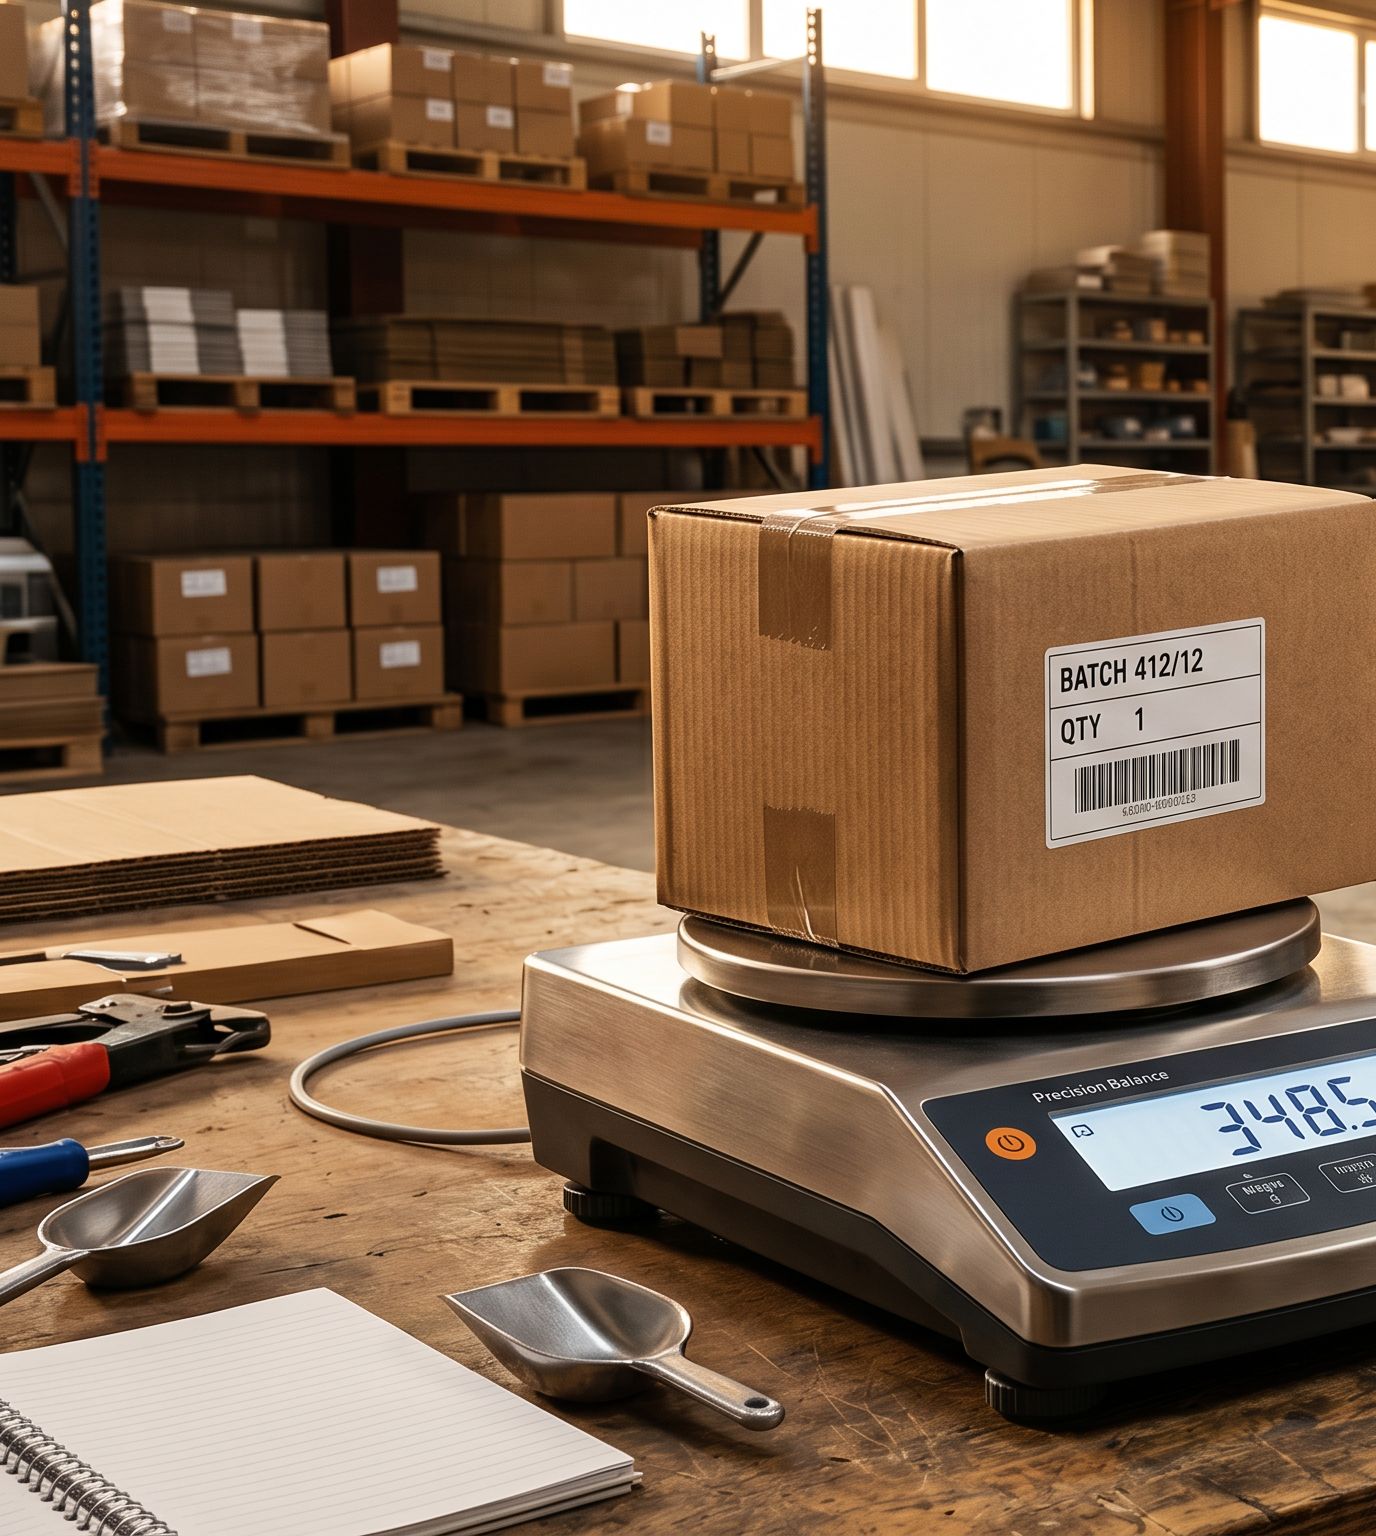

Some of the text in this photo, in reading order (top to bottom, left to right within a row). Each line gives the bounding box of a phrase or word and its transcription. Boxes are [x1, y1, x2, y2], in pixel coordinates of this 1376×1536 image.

[1060, 648, 1203, 693] BATCH 412/12
[1060, 707, 1143, 745] QTY 1
[1032, 1071, 1170, 1103] Precision Balance
